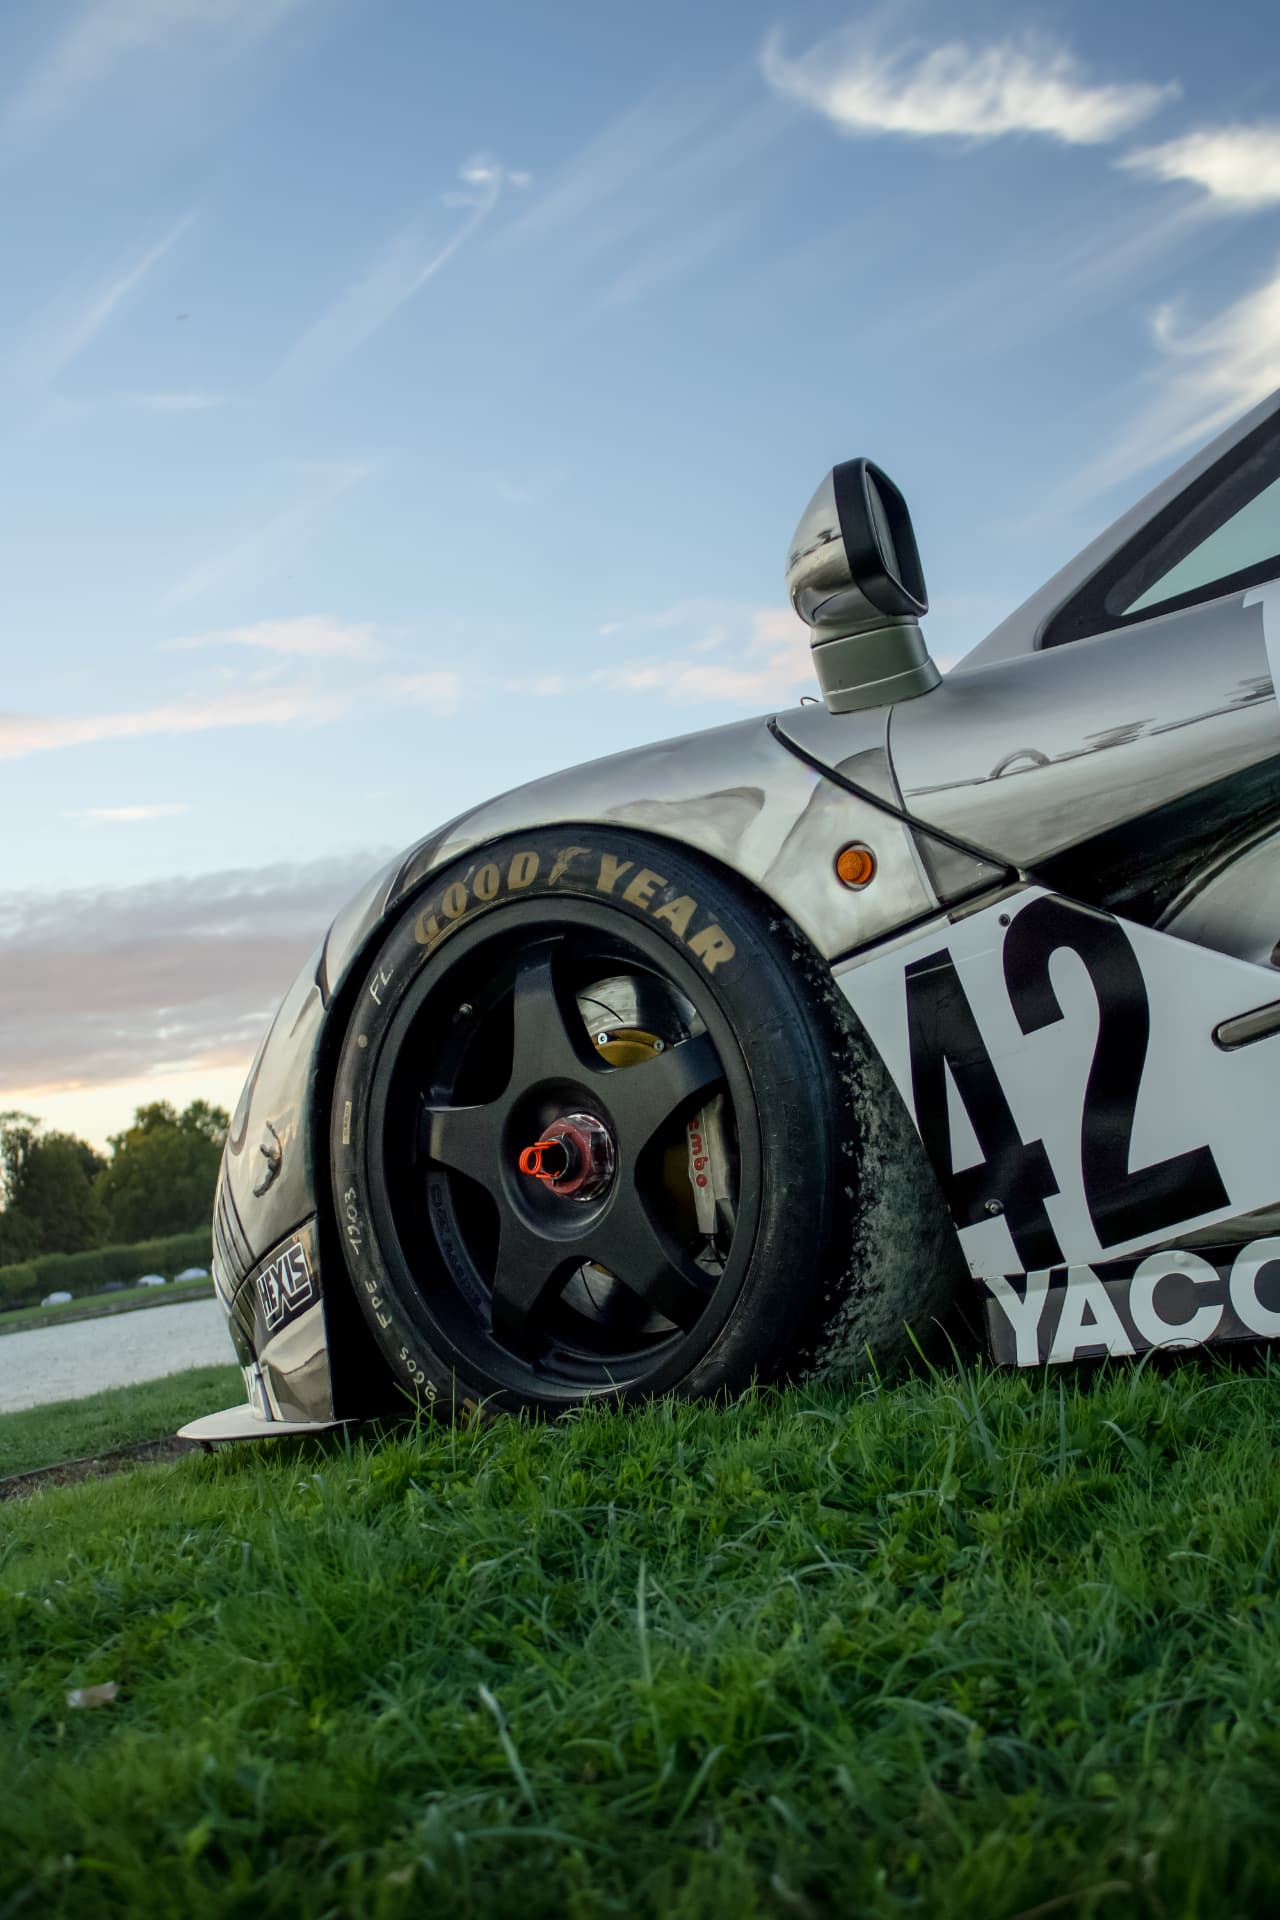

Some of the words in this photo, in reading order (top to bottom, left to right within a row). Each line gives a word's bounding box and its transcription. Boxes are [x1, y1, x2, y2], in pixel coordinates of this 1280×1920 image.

[369, 967, 394, 1006] FL
[905, 892, 1231, 1273] 42
[688, 1119, 709, 1188] embo
[257, 1243, 312, 1322] HEXIS
